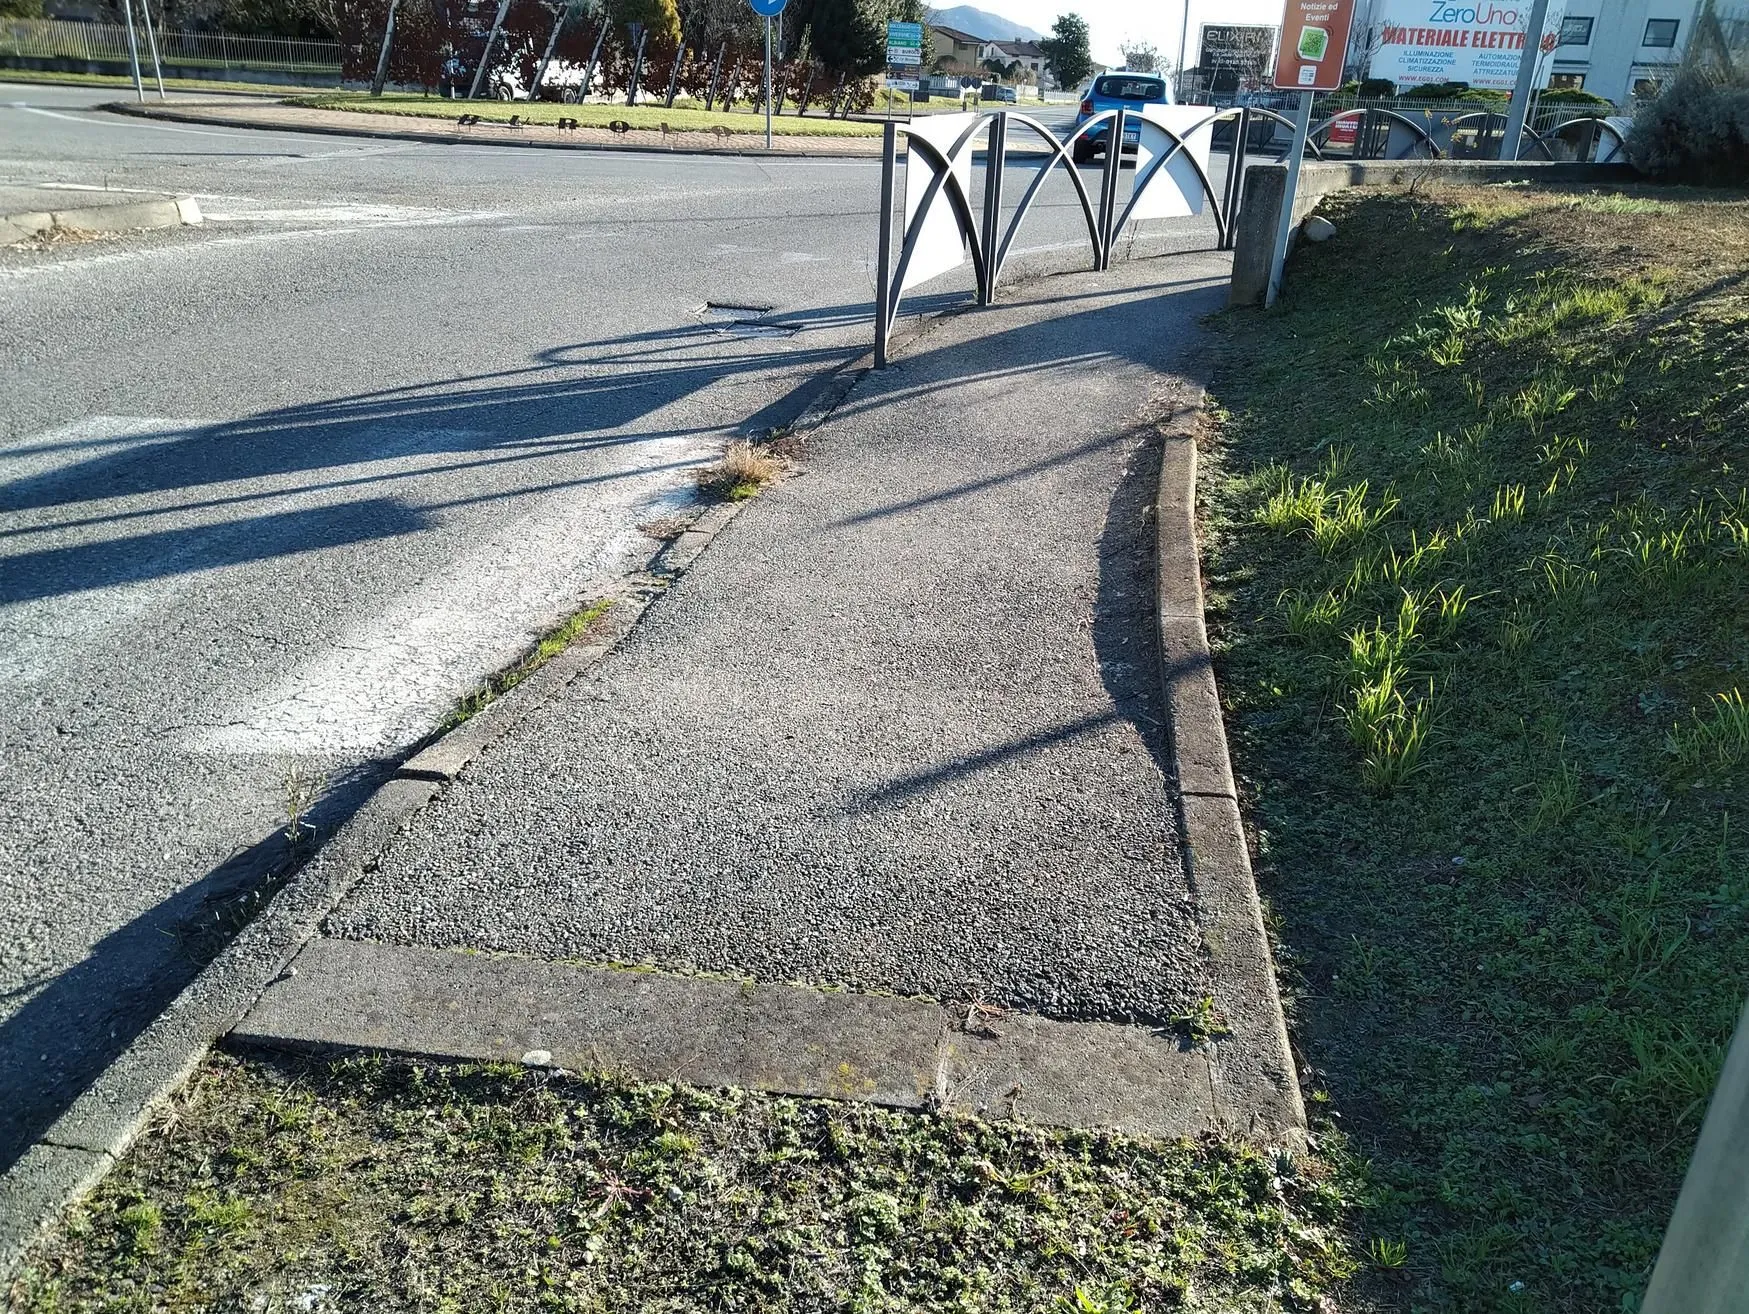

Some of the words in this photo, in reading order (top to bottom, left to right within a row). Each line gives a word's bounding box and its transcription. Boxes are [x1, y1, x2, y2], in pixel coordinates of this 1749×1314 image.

[1429, 0, 1517, 25] ZeroUno
[1382, 26, 1469, 48] MATERIALE
[1472, 30, 1556, 52] ELETTRO
[1403, 50, 1454, 58] ILLUMINAZIONE
[1398, 57, 1456, 65] CLIMATIZZAZIONE
[1472, 60, 1519, 68] TERMOIDRAUL
[1407, 65, 1444, 73] SICUREZZA
[1473, 68, 1518, 76] ATTREZZATU
[1472, 78, 1516, 86] WWW.EG01.CO
